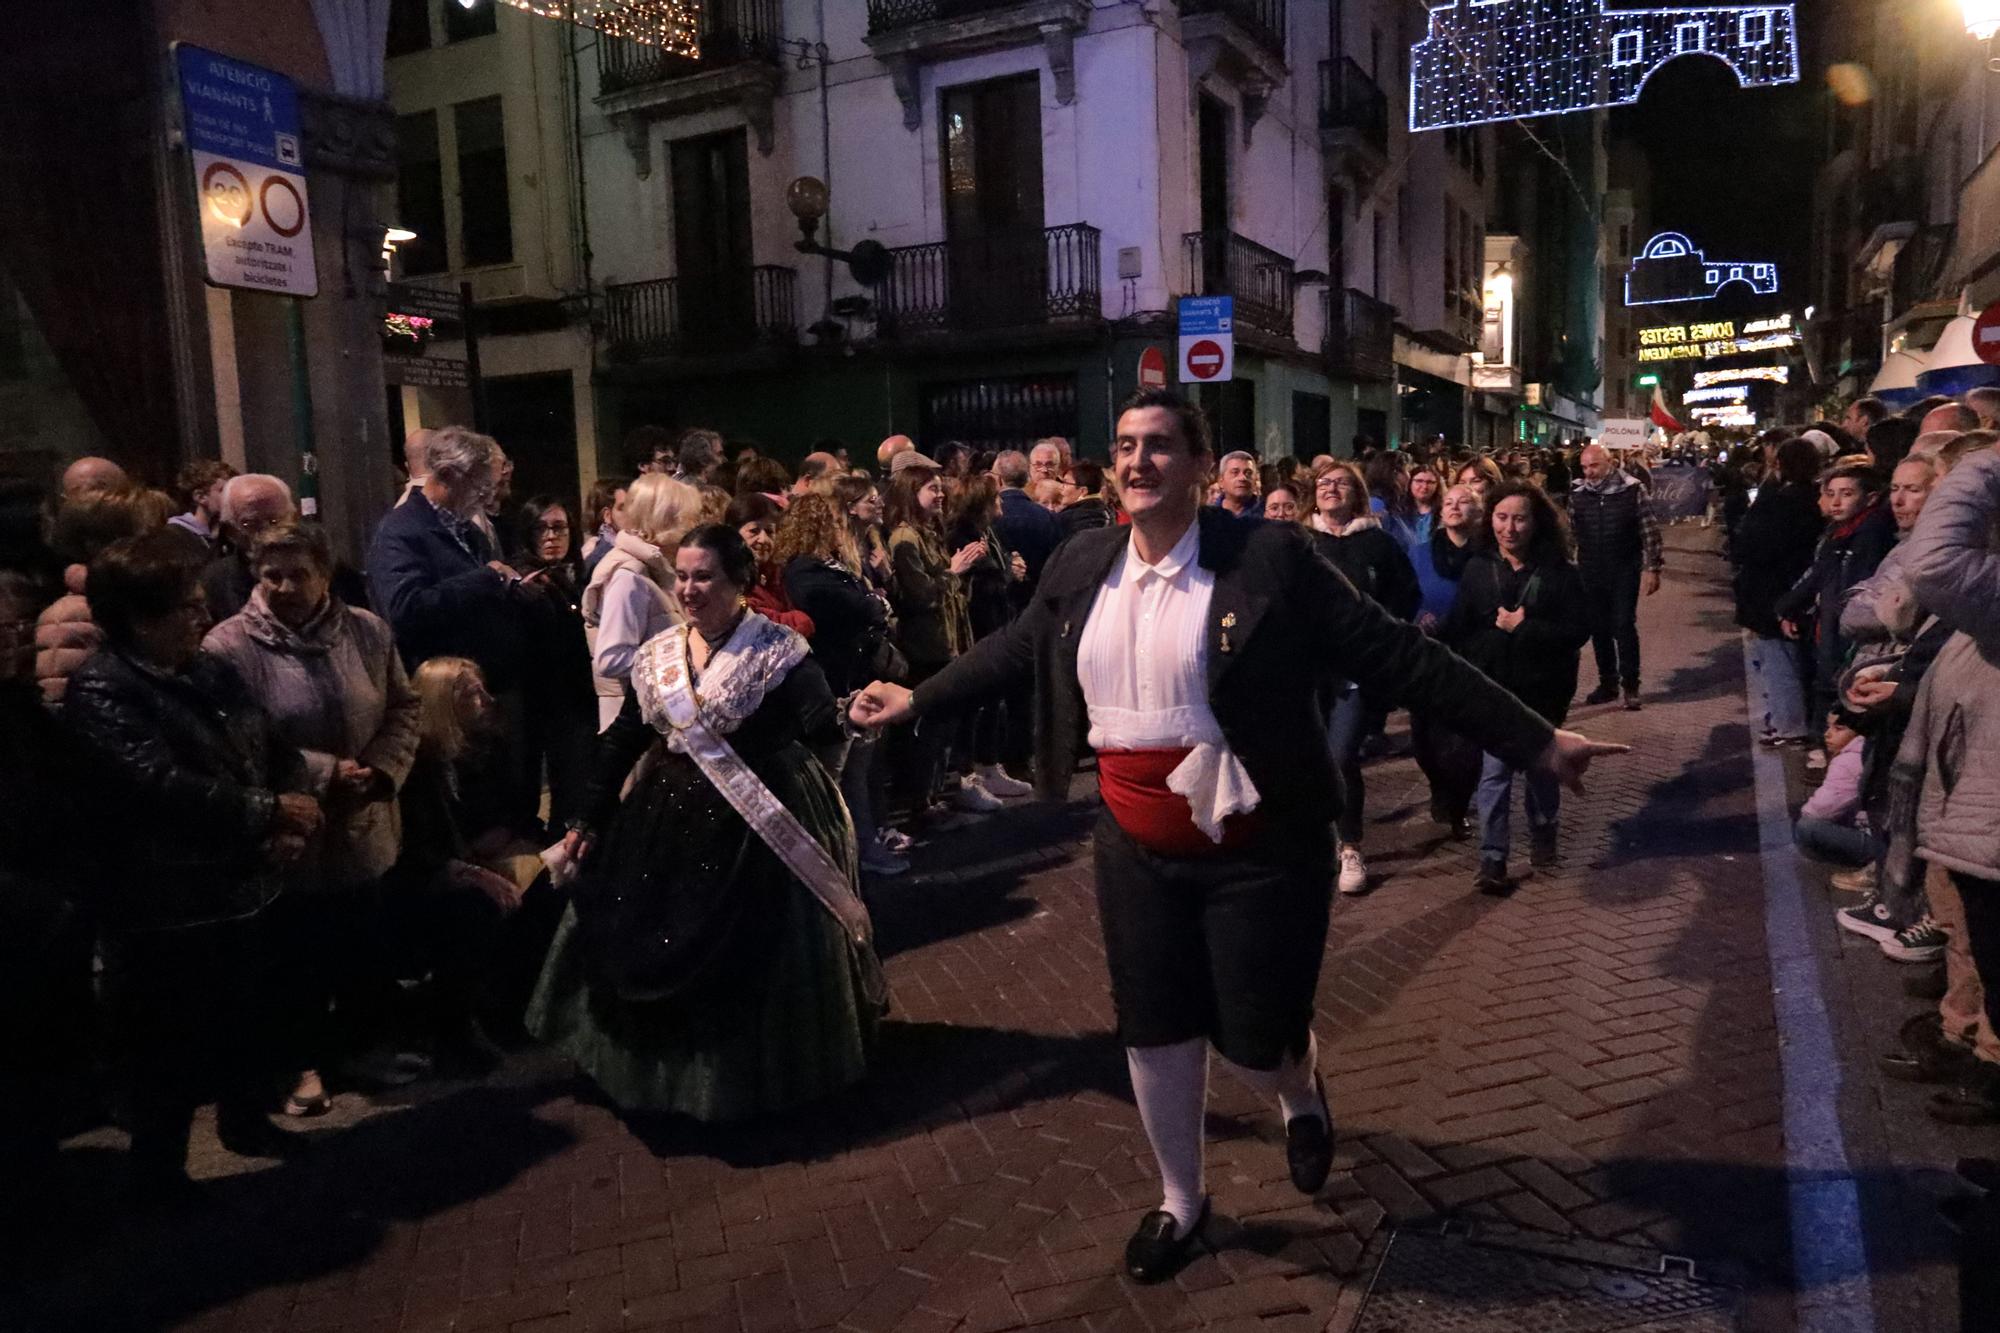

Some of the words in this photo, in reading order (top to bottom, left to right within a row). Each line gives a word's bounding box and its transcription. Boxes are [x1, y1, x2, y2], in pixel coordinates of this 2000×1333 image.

[185, 80, 257, 112] VIANANTS
[225, 236, 264, 252] Excepte
[243, 271, 288, 287] bicicletes
